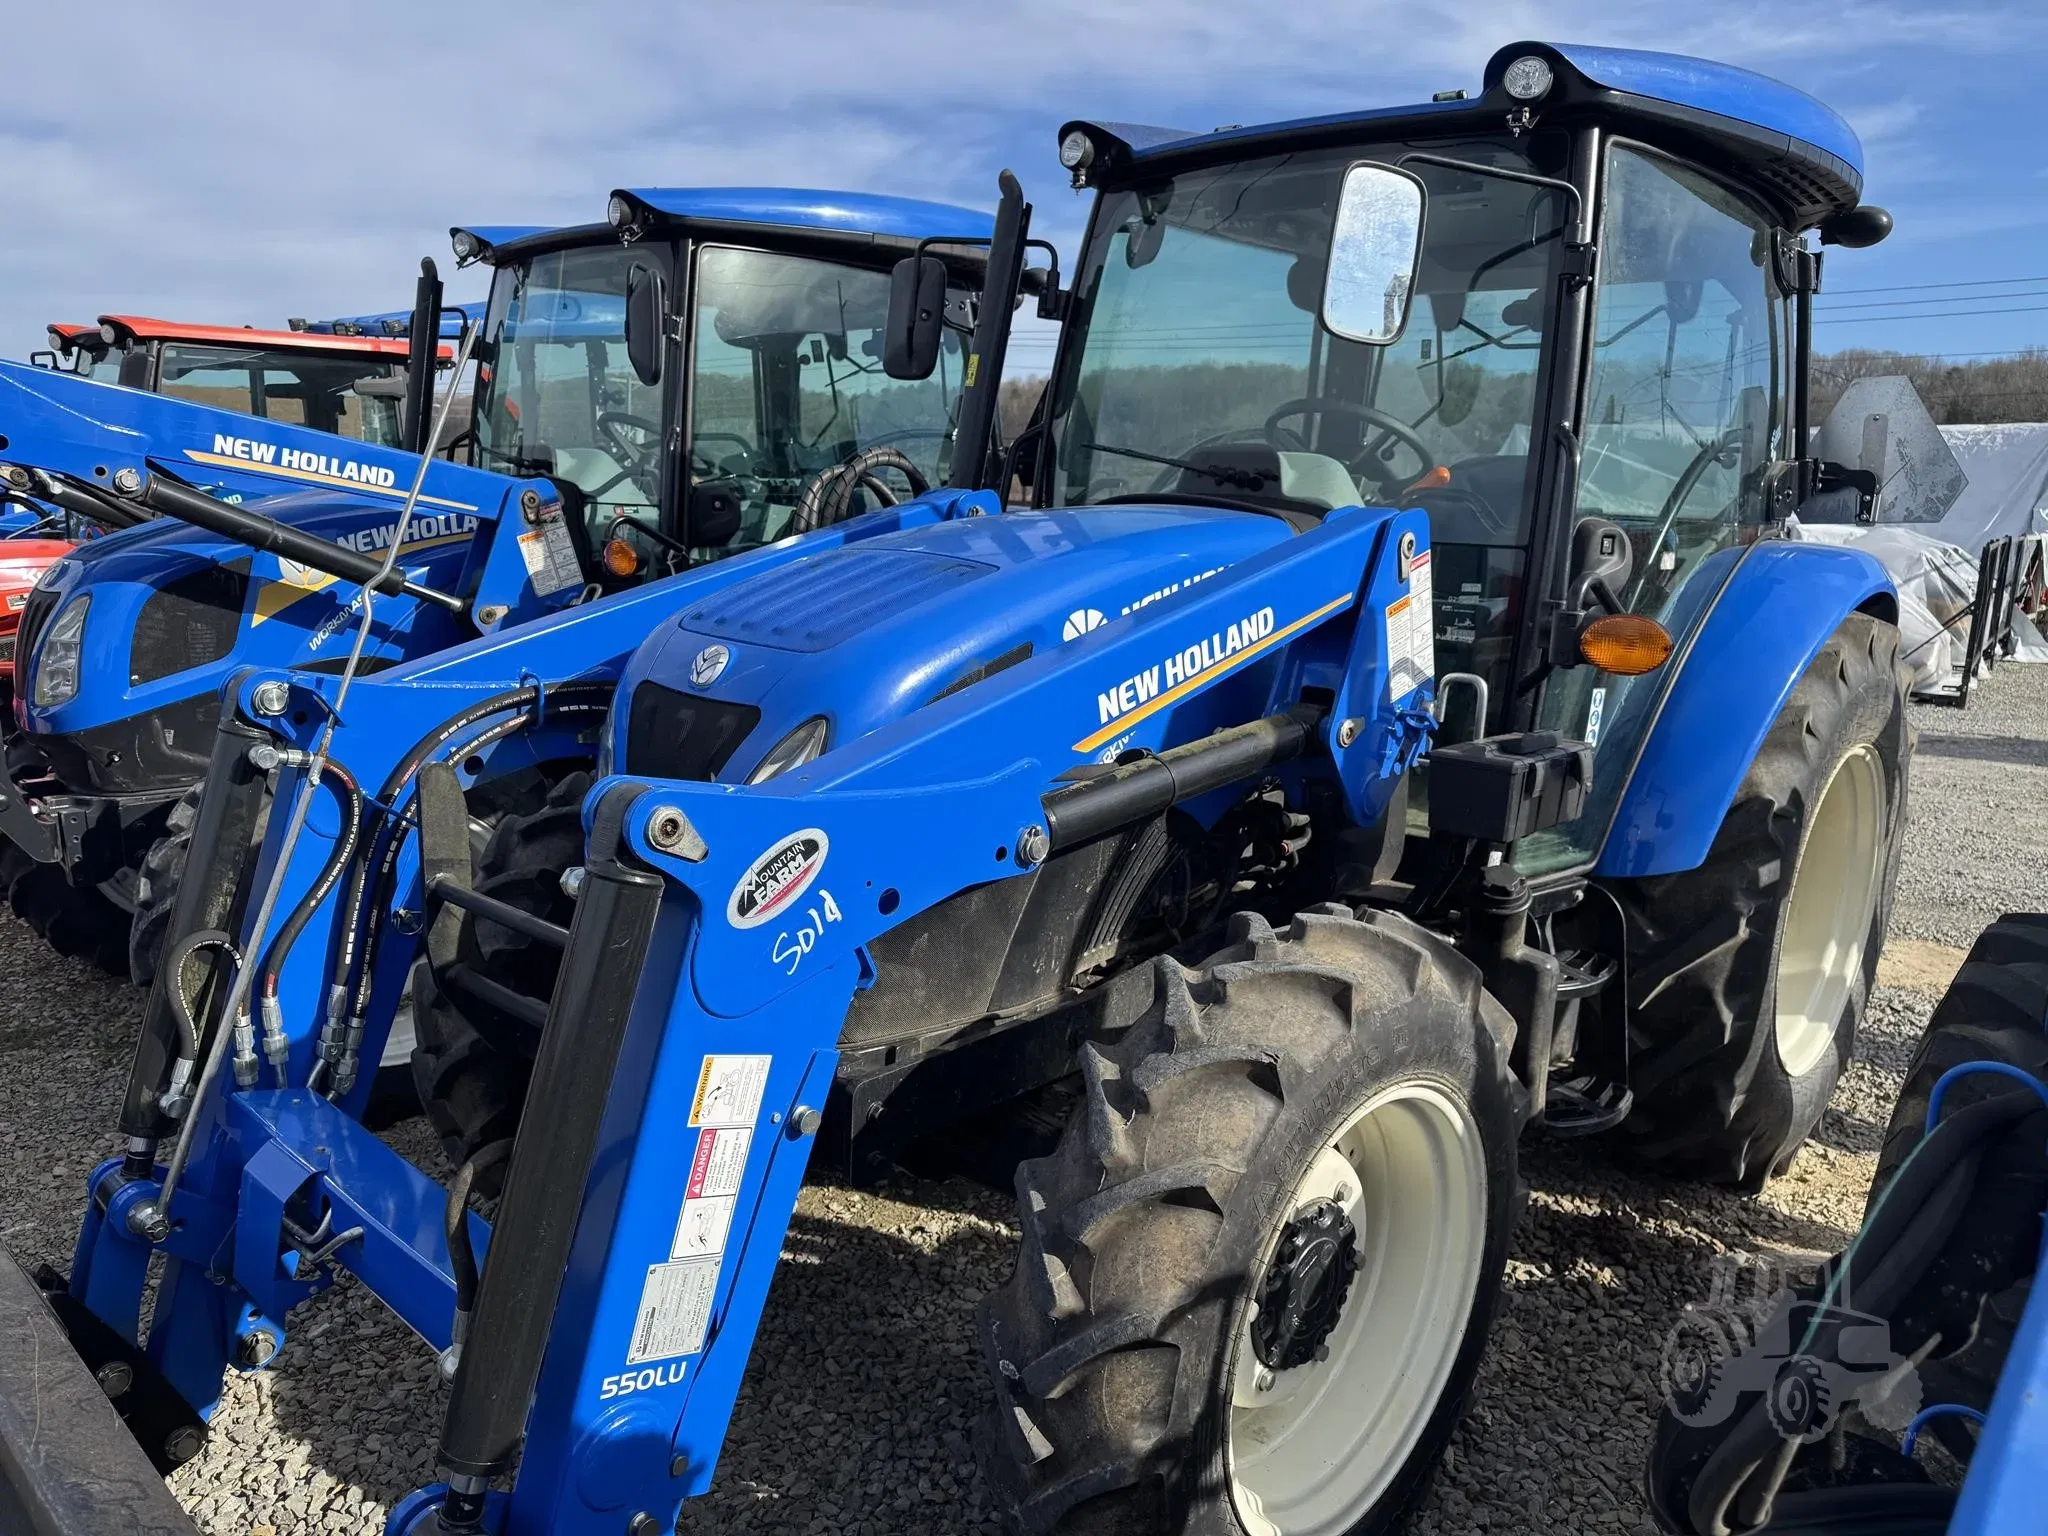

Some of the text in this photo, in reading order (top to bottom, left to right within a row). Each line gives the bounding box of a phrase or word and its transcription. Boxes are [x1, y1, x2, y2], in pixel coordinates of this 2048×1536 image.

[213, 433, 395, 488] NEW HOLLAND
[336, 513, 480, 552] NEW HOLLA
[1097, 606, 1275, 725] NEW HOLLAND
[752, 853, 806, 905] FARM
[772, 889, 842, 976] Sold
[696, 1061, 712, 1107] WARNING
[694, 1133, 713, 1181] DANGER
[600, 1361, 687, 1400] 550LU
